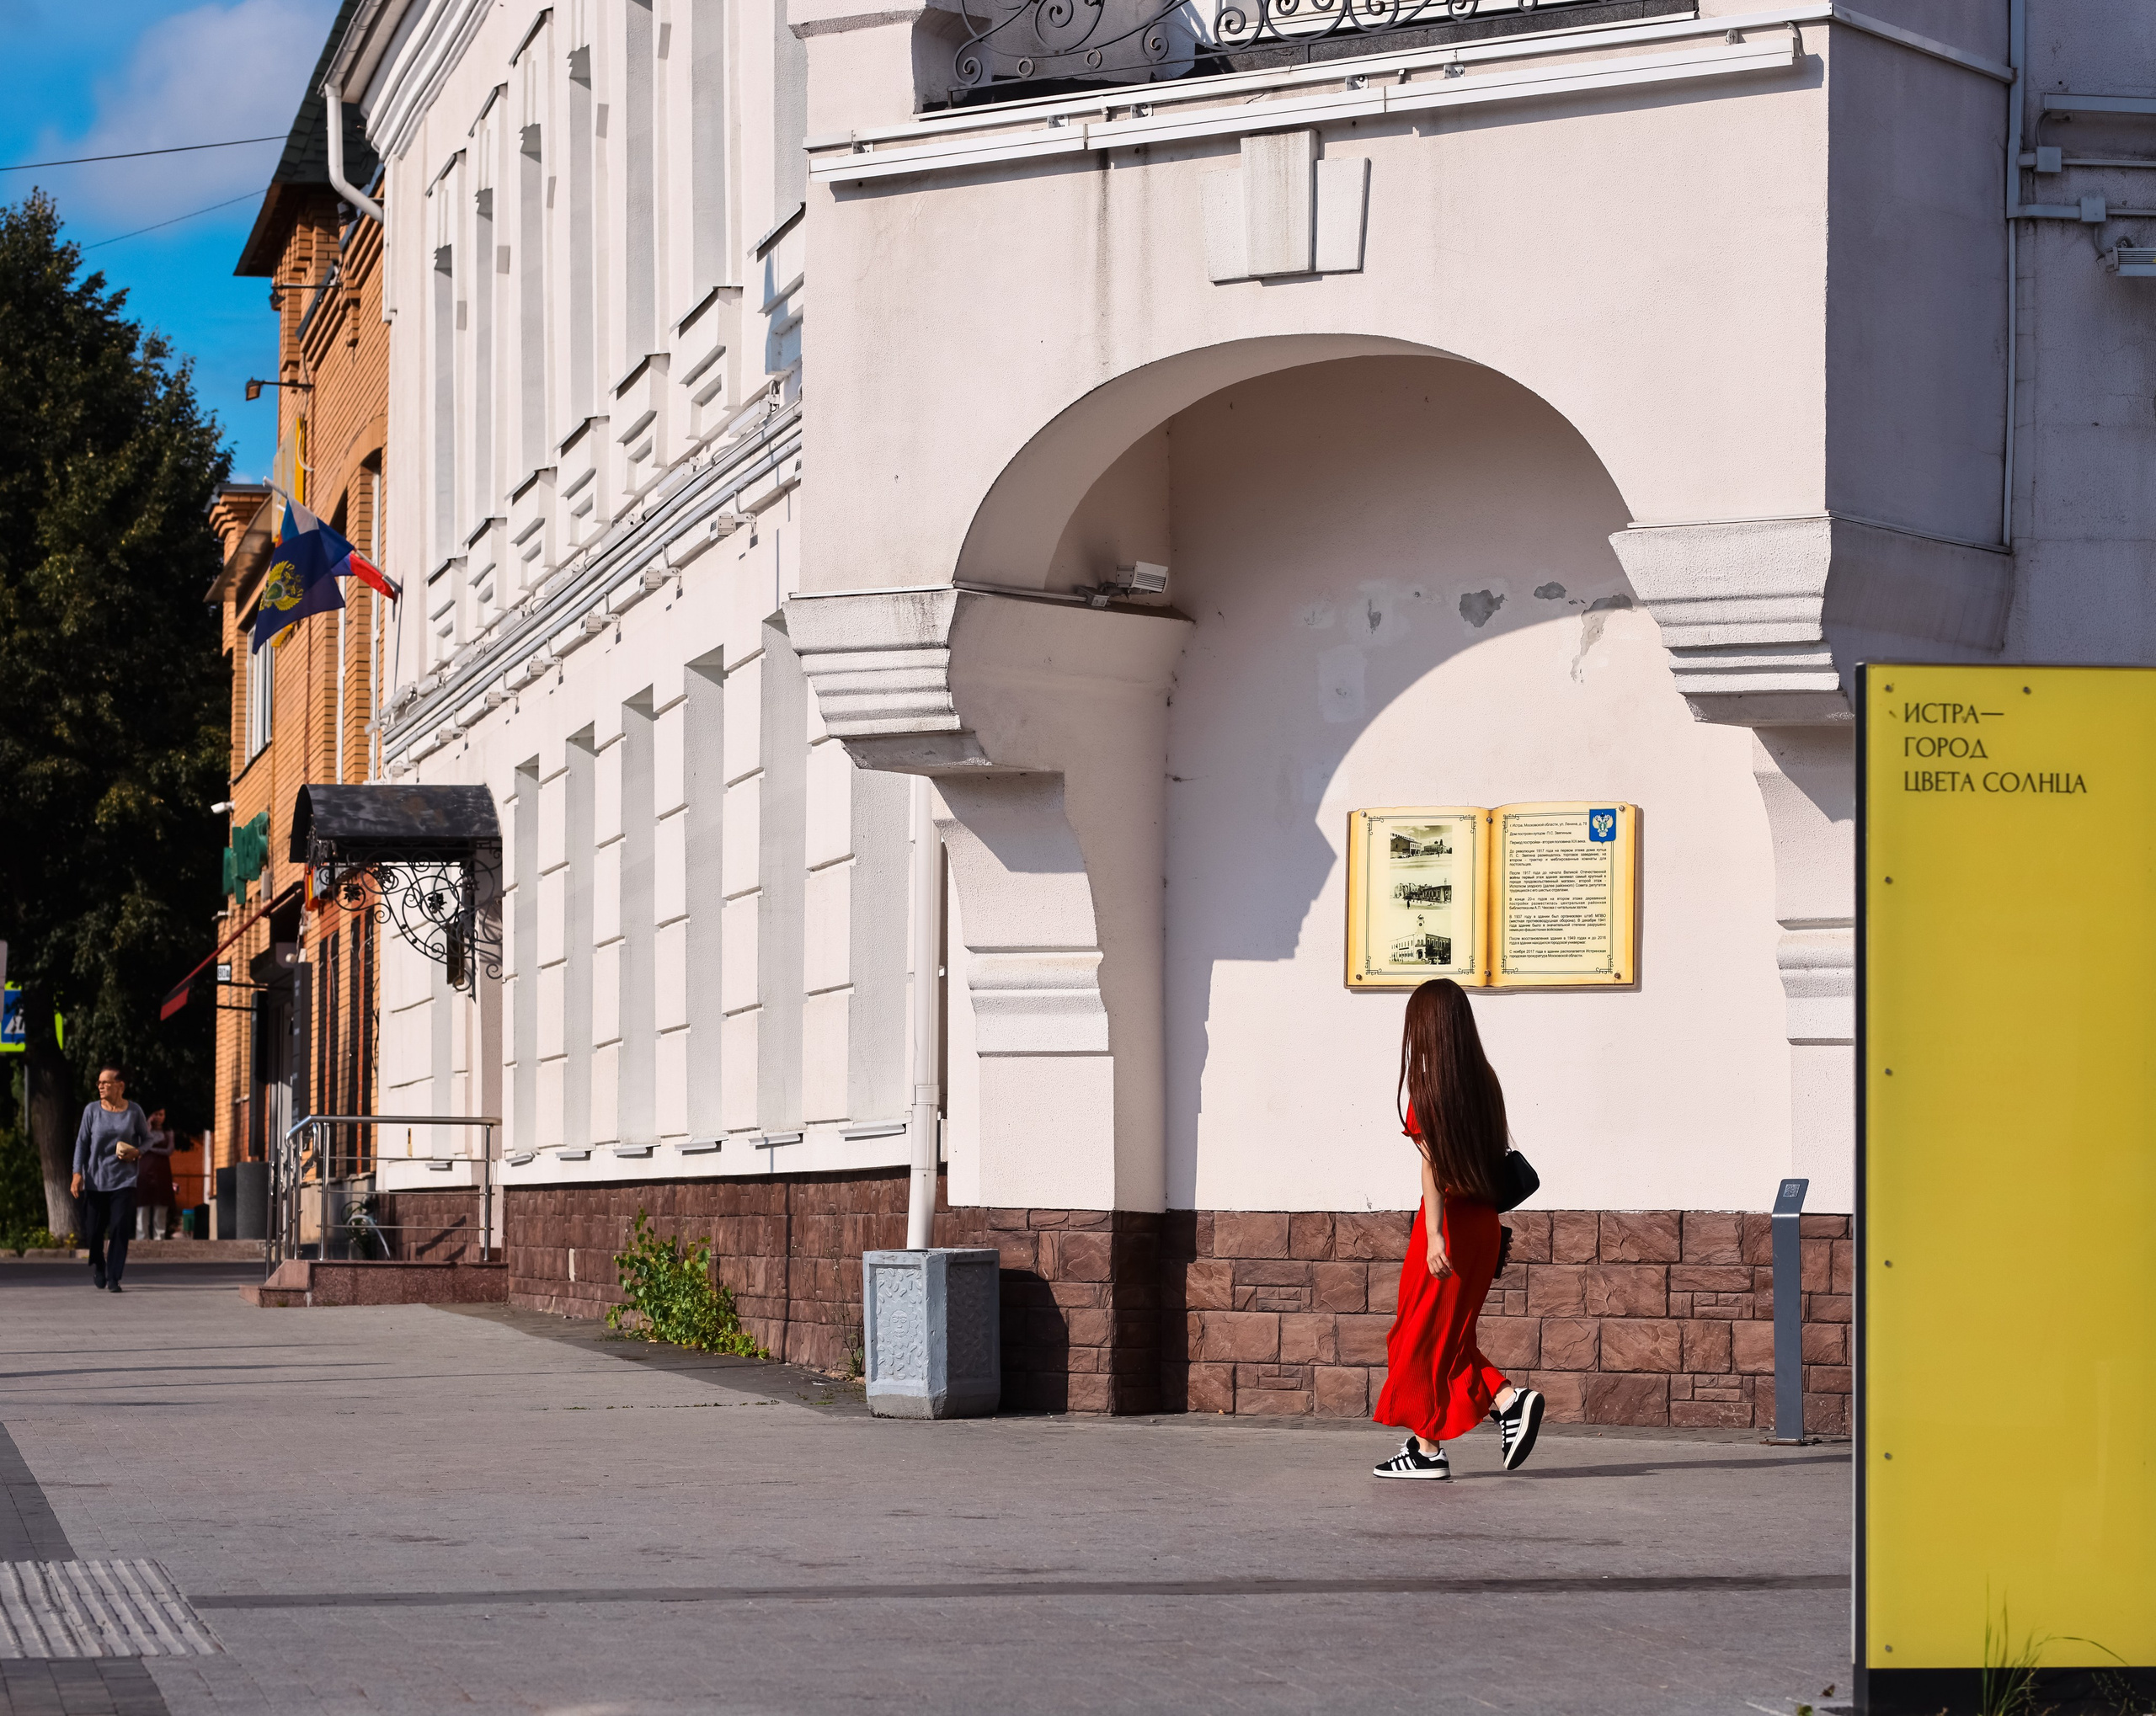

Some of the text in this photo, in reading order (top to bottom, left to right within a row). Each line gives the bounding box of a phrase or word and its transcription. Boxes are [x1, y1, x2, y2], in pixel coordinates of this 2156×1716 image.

[1904, 737, 1988, 759] ГОРОД
[1904, 770, 2088, 794] ЦВЕТА СОЛНЦА
